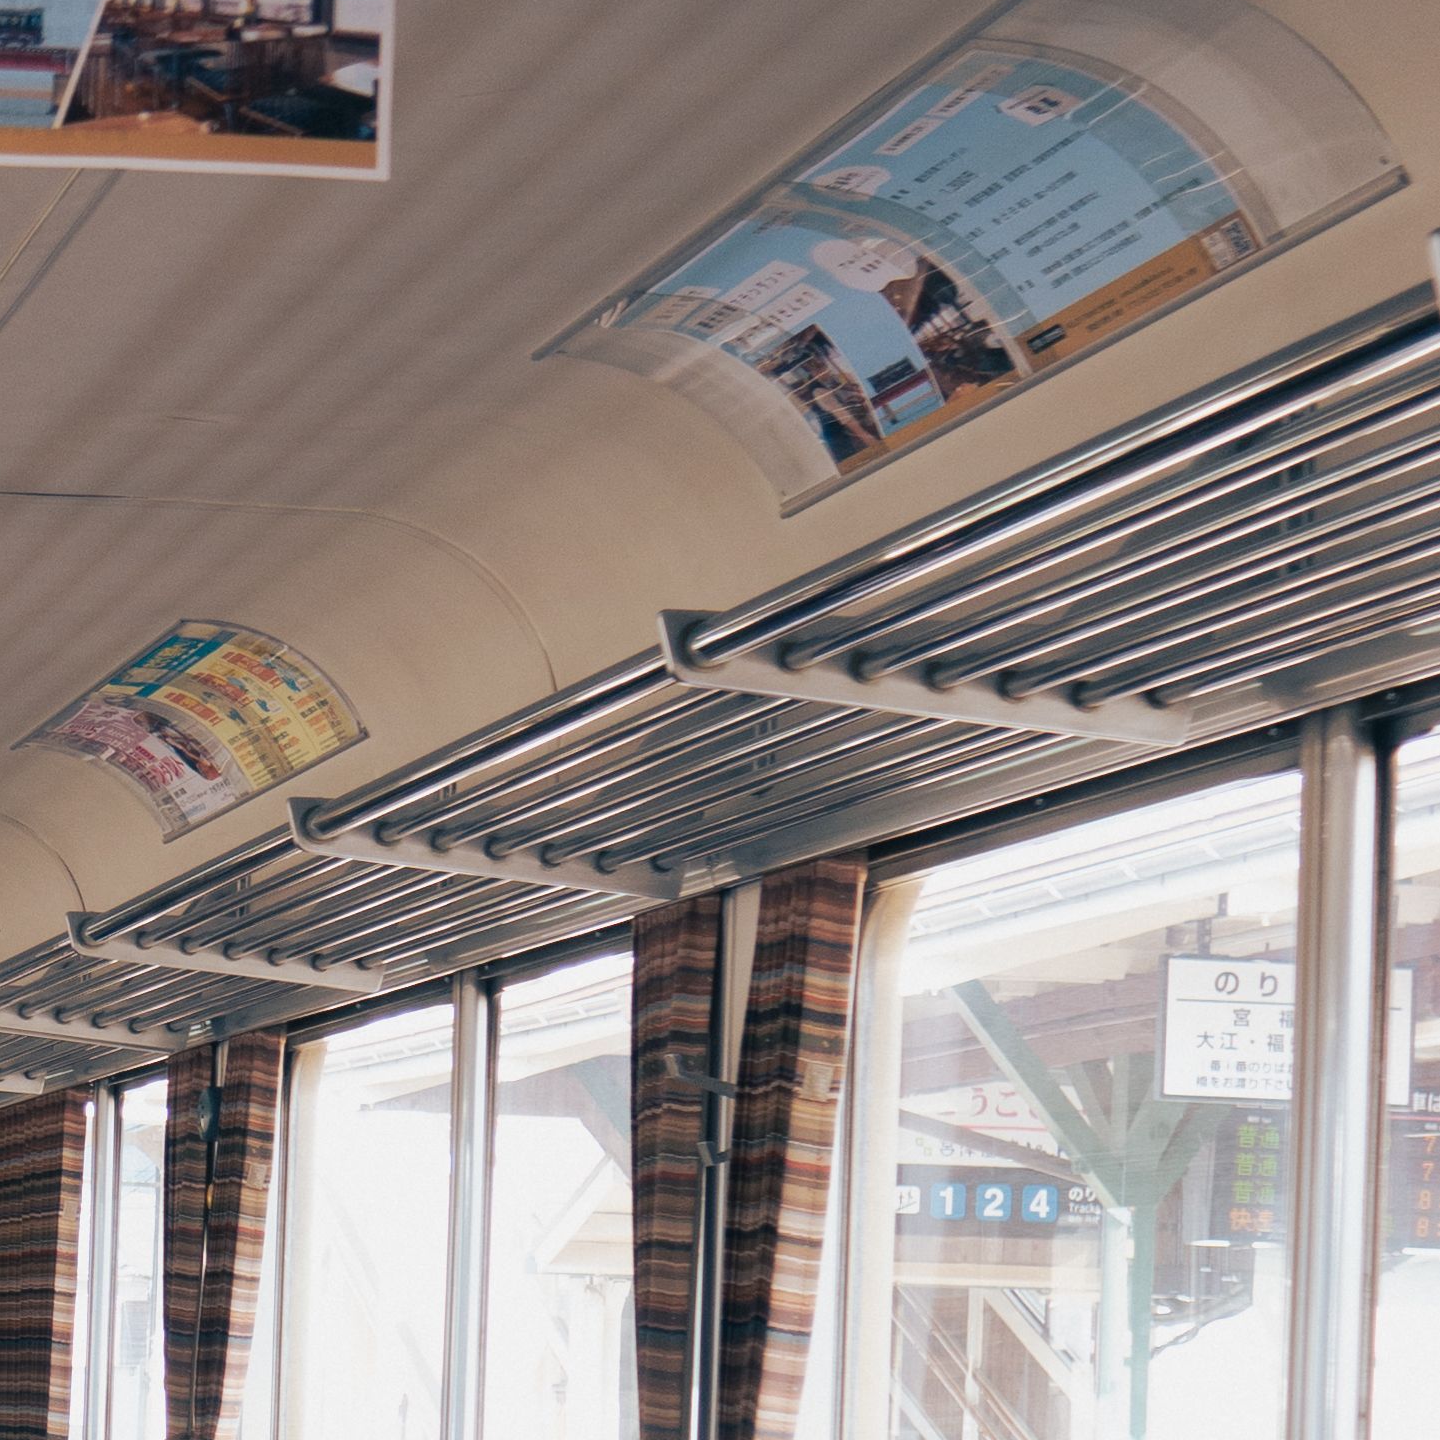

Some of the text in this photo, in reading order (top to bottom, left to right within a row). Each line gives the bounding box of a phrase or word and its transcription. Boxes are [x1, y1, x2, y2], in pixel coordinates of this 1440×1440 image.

[1196, 1030, 1294, 1053] 大江・福
[1237, 1124, 1280, 1149] 普通
[1235, 1152, 1277, 1177] 普通
[940, 1185, 1050, 1219] 1 2 4
[1068, 1186, 1096, 1202] のり
[1232, 1181, 1275, 1204] 普通
